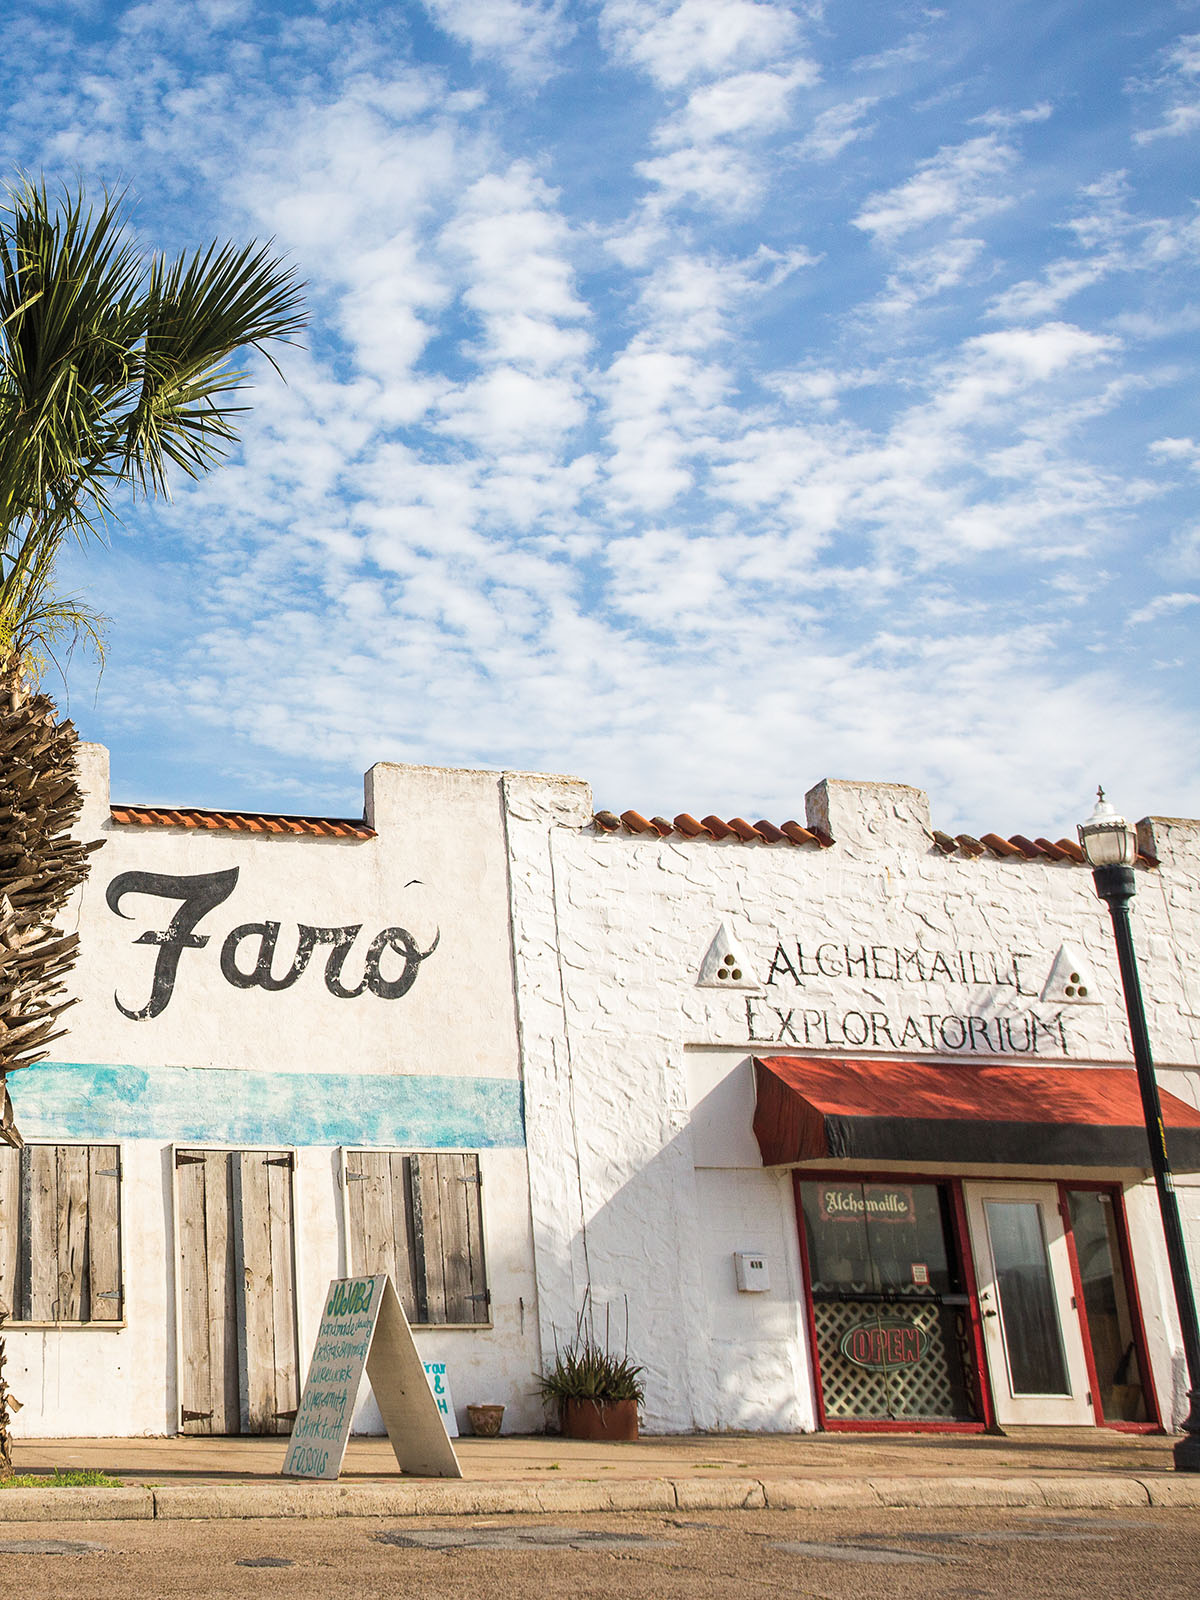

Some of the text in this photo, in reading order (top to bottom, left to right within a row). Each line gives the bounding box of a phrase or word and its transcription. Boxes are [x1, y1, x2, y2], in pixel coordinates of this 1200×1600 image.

[105, 865, 441, 1022] Faro
[764, 941, 1039, 998] ALCHEMAILLE
[744, 994, 1070, 1056] EXPLORATORIUM
[825, 1191, 909, 1214] Alchemaille
[853, 1328, 921, 1363] OPEN
[434, 1374, 445, 1395] &
